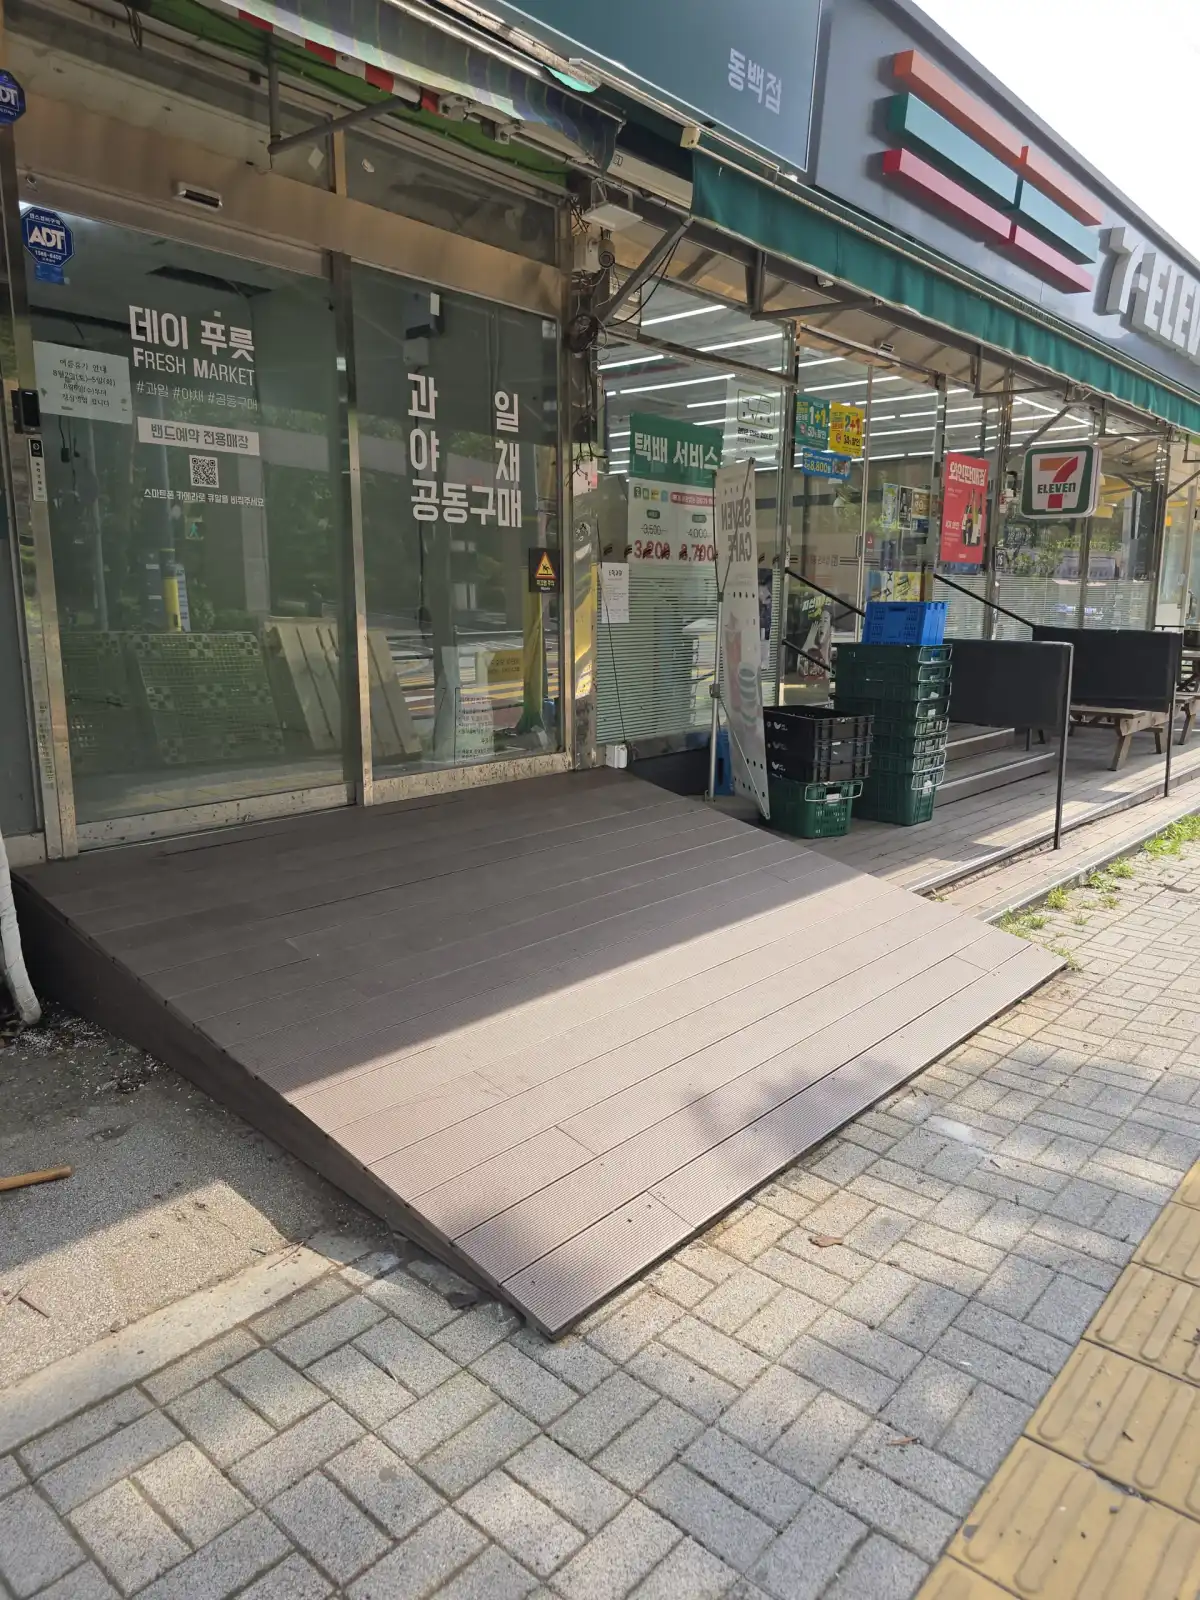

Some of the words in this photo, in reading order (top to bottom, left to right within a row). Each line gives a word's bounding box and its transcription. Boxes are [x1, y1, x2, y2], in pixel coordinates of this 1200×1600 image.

[0, 85, 18, 104] DT
[728, 47, 782, 115] 동백점
[28, 226, 65, 250] ADT
[129, 304, 189, 350] 데이
[200, 310, 255, 363] 푸릇
[132, 346, 186, 375] FRESH
[193, 357, 255, 386] MARKET
[136, 380, 169, 397] #과일
[173, 386, 204, 402] #야채
[207, 391, 258, 411] #공동구매
[151, 423, 200, 443] 밴드예약
[203, 430, 249, 450] 전용매장
[634, 431, 668, 463] 택배
[672, 440, 718, 470] 서비스
[410, 479, 522, 528] 공동구매
